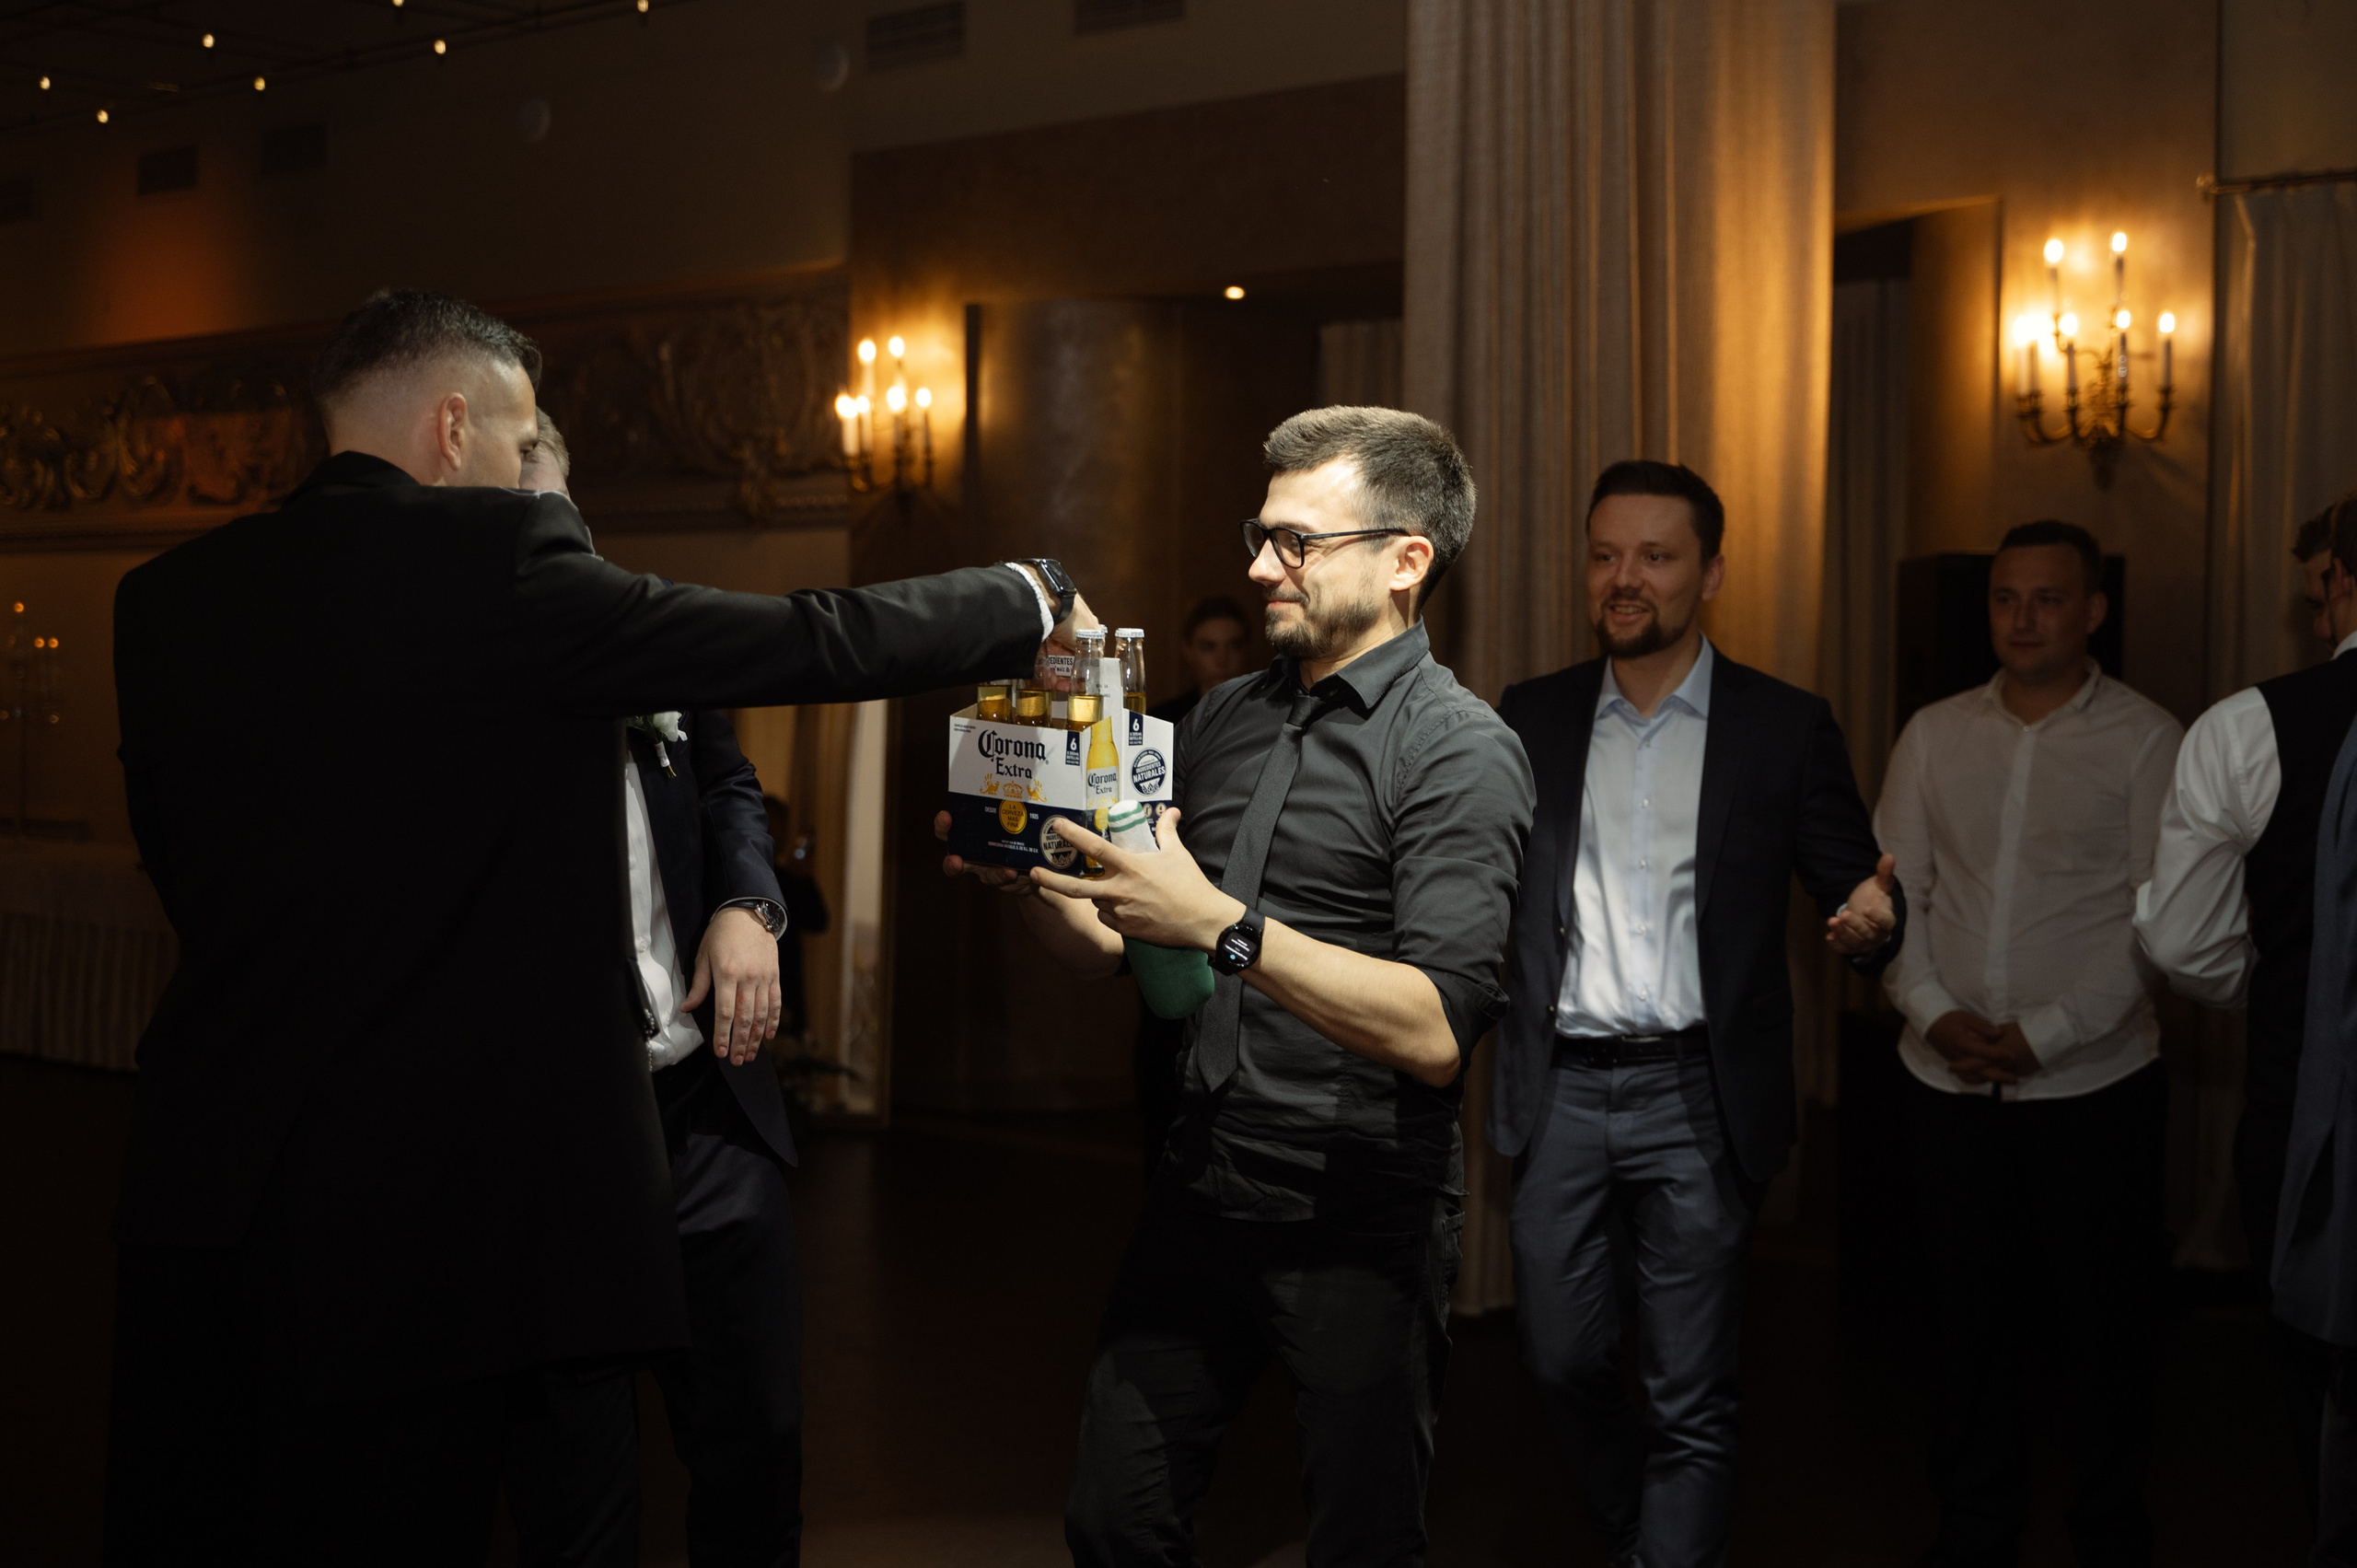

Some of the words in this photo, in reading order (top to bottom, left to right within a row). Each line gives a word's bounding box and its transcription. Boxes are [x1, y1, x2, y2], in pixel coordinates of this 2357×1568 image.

[1132, 718, 1140, 732] 6
[978, 729, 1046, 762] Corona
[1070, 738, 1077, 751] 6
[995, 757, 1033, 780] Extra
[1132, 766, 1166, 784] NATURALES
[1087, 772, 1118, 789] Corona
[1095, 784, 1112, 795] Extra
[1002, 809, 1025, 818] CERVEZA
[1043, 840, 1073, 851] NATURAL
